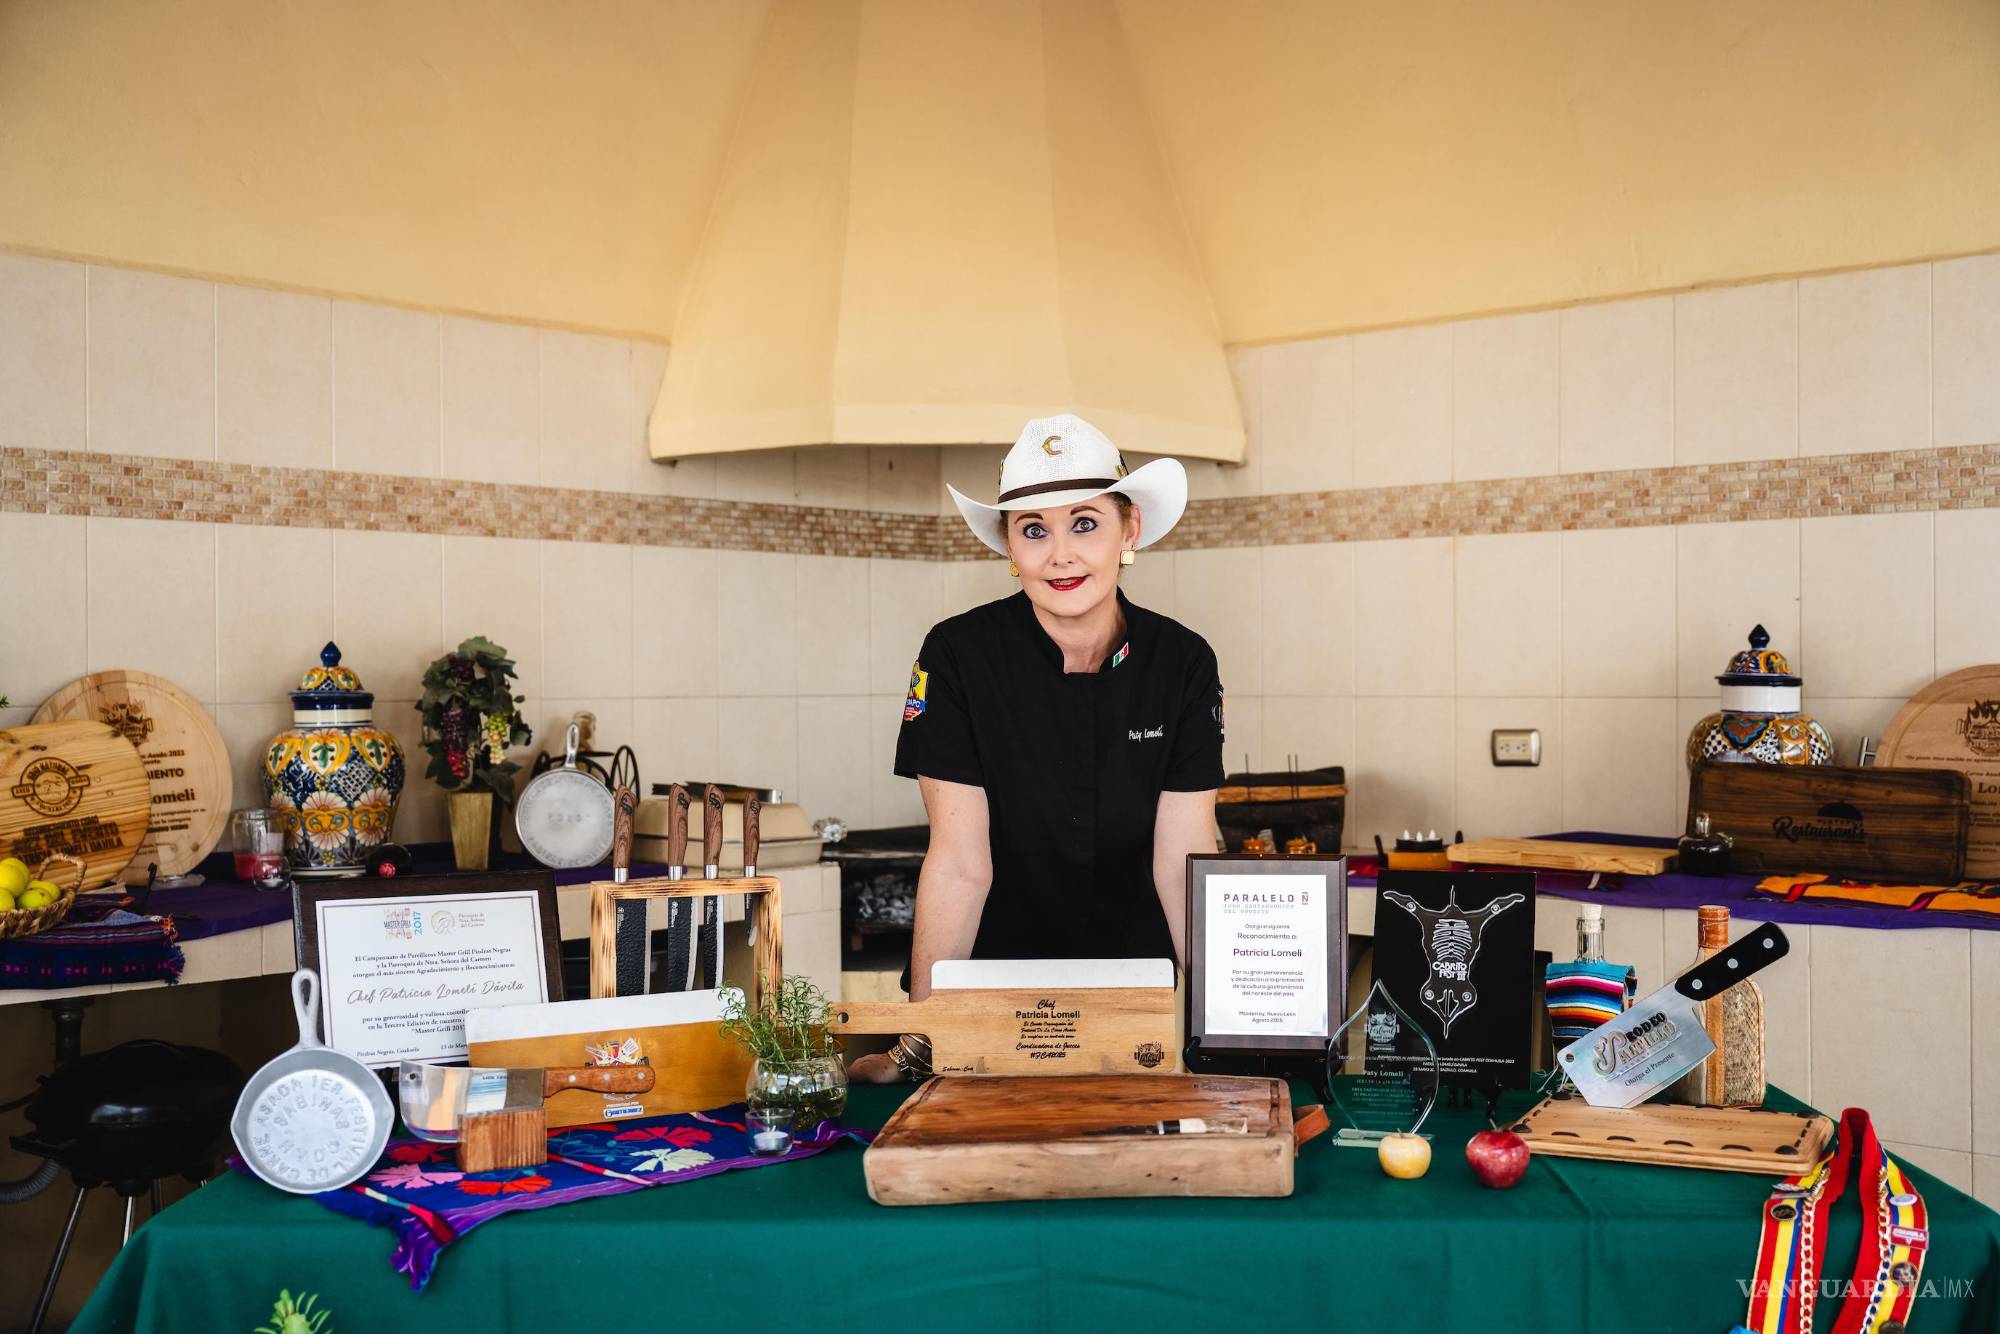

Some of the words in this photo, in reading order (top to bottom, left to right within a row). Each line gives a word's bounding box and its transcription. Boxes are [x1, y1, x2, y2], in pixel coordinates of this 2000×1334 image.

[1128, 729, 1142, 742] Paty
[151, 788, 195, 805] omeli
[1224, 894, 1294, 902] PARALELO
[413, 911, 423, 935] 2017
[1238, 932, 1290, 940] Reconocimiento
[1233, 948, 1269, 957] Patricia
[1432, 961, 1467, 970] CABRITO
[1439, 970, 1456, 978] FEST
[347, 988, 374, 1004] Chef
[380, 987, 432, 1002] Patricia
[480, 980, 525, 995] Dávila
[1038, 1000, 1055, 1010] Chef
[383, 1012, 419, 1022] generosidad
[1625, 1012, 1667, 1042] RODEO
[1016, 1042, 1054, 1050] Coordinadora
[1624, 1072, 1646, 1086] Otorga
[1651, 1052, 1675, 1069] Presente
[256, 1077, 303, 1127] ASADA
[333, 1096, 367, 1173] FESTIVAL
[253, 1132, 301, 1182] CARNE
[307, 1167, 329, 1182] DE
